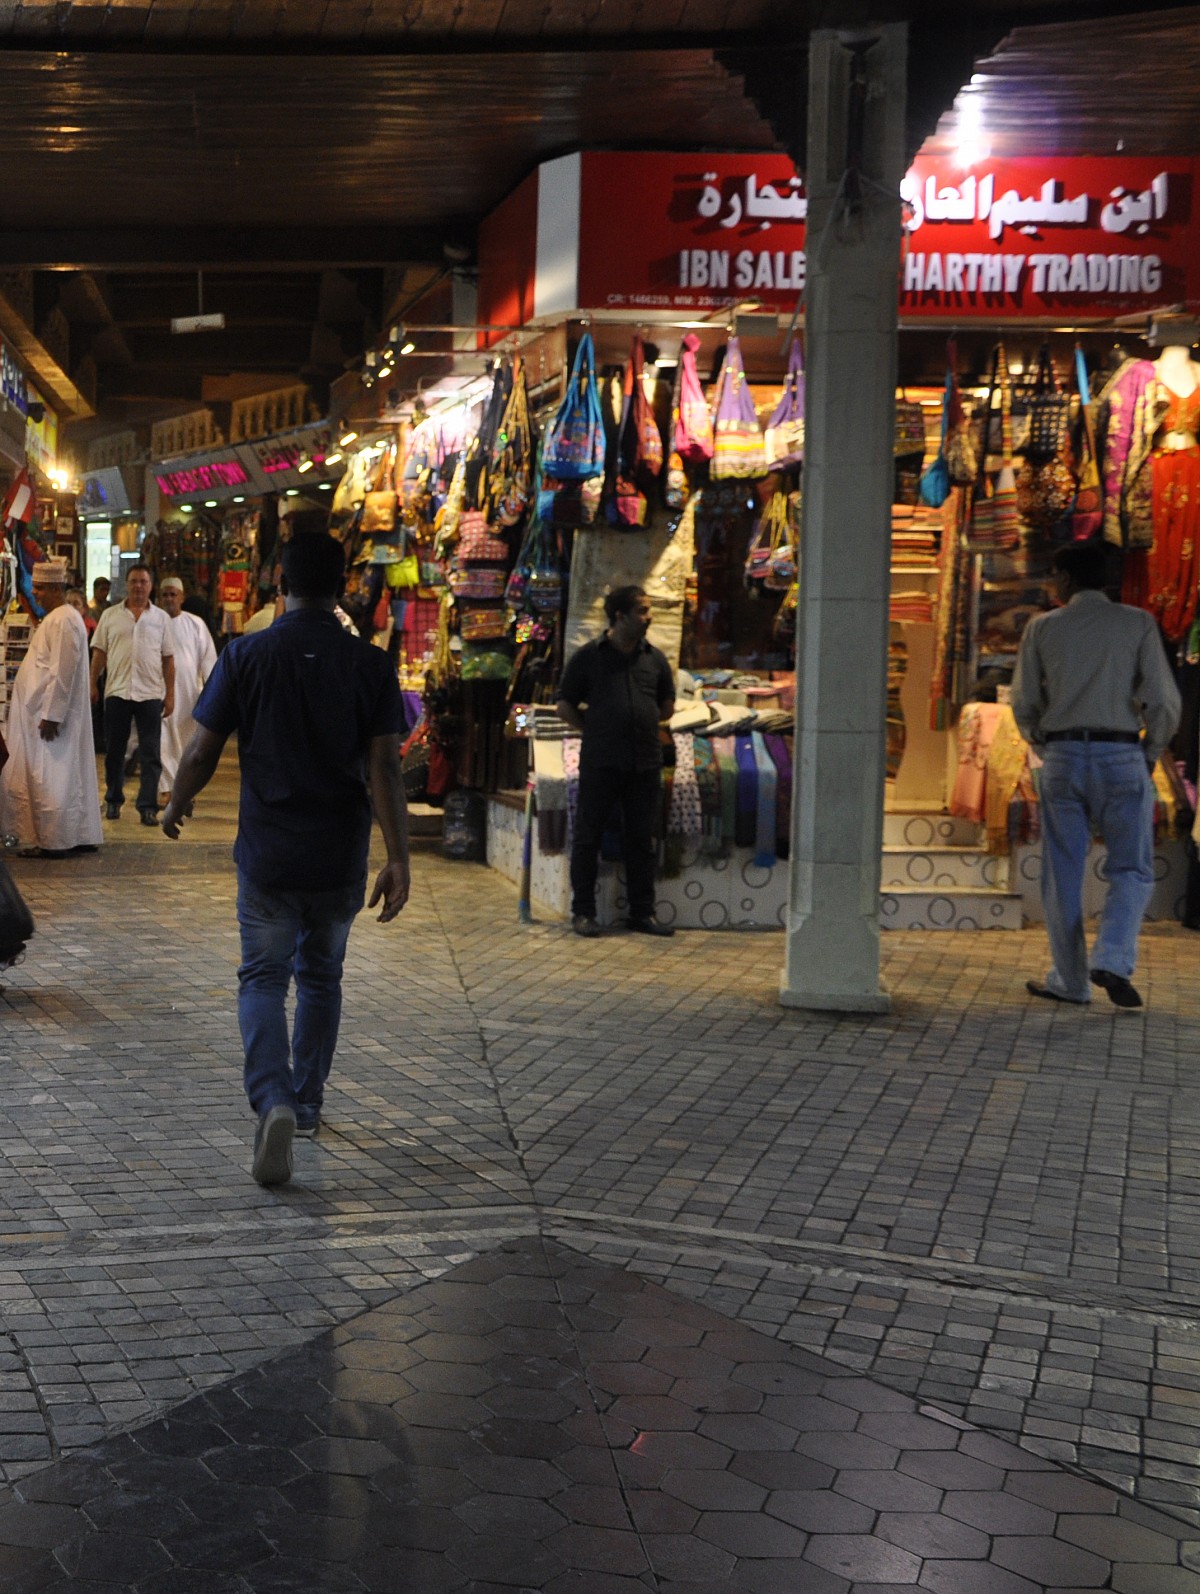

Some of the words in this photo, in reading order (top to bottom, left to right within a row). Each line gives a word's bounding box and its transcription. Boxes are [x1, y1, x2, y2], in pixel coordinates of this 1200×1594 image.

[989, 177, 1089, 240] سليم
[1100, 171, 1169, 234] ابن
[679, 249, 729, 289] IBN
[904, 252, 1027, 294] HARTHY
[1029, 253, 1163, 294] TRADING
